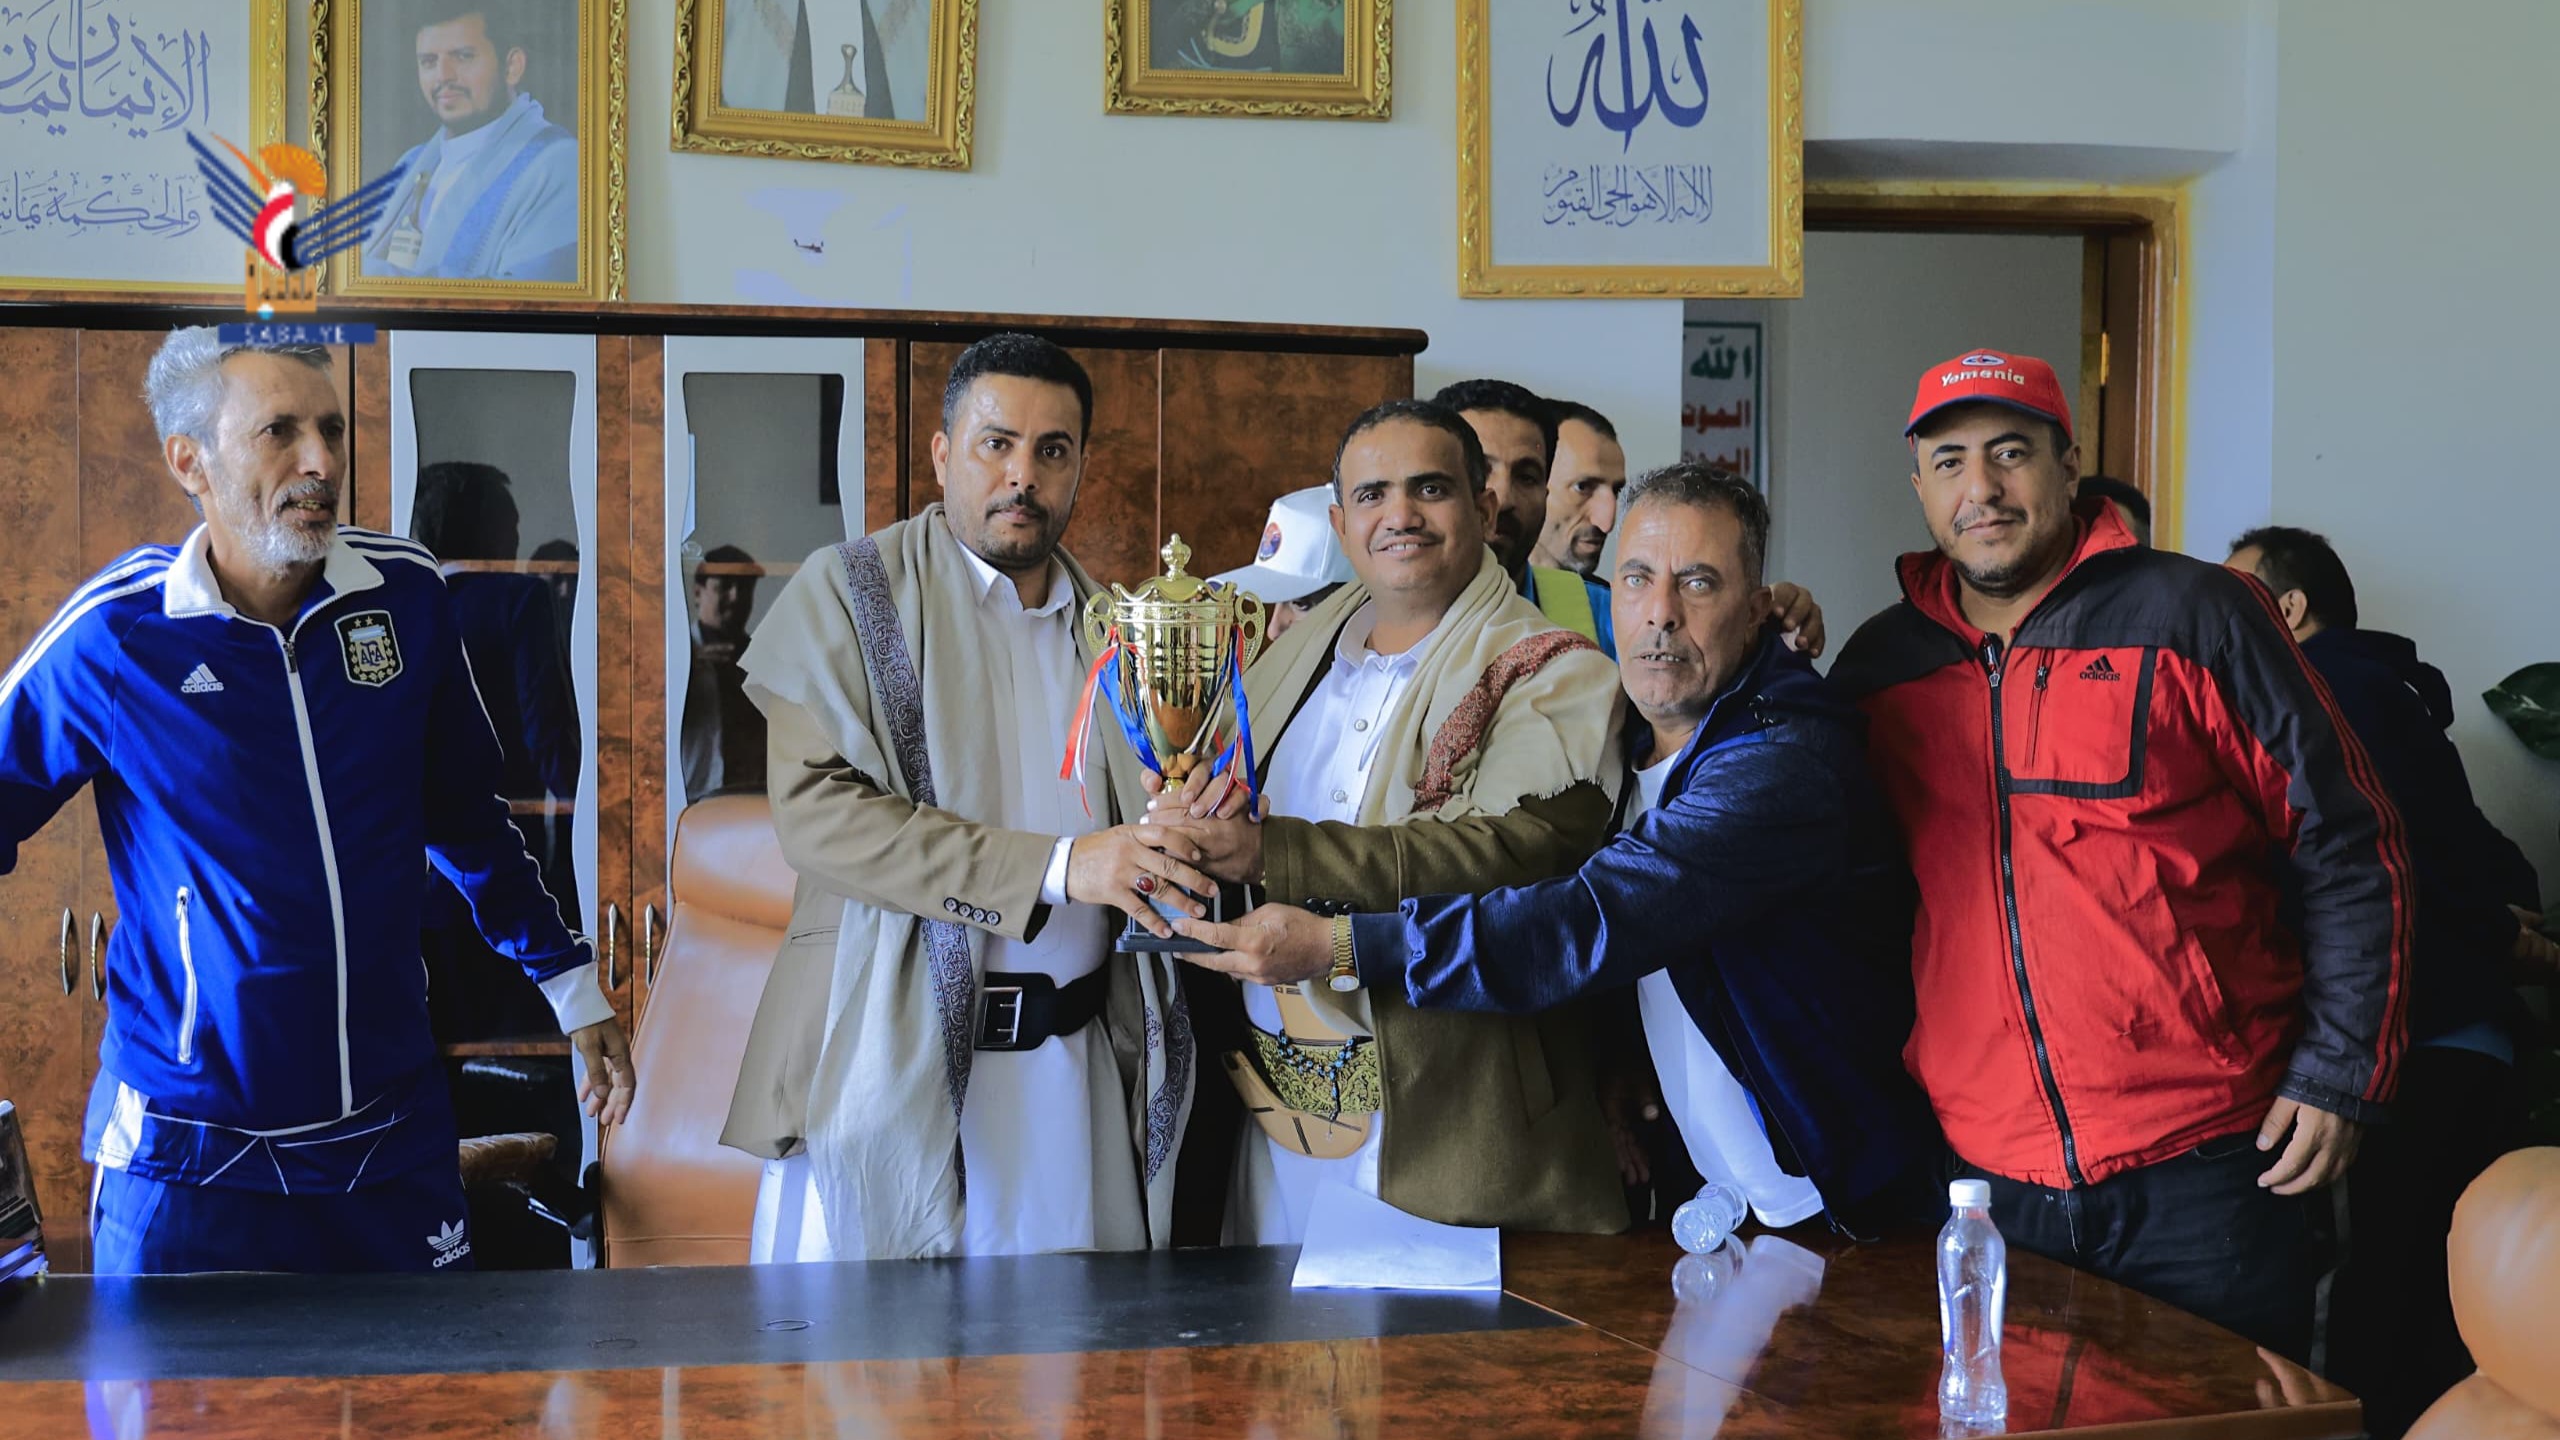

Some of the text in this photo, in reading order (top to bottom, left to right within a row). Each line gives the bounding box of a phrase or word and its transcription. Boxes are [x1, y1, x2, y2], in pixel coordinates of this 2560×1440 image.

[1690, 334, 1752, 380] الله
[2079, 670, 2121, 681] adidas
[180, 681, 225, 693] adidas
[432, 1241, 471, 1268] adidas
